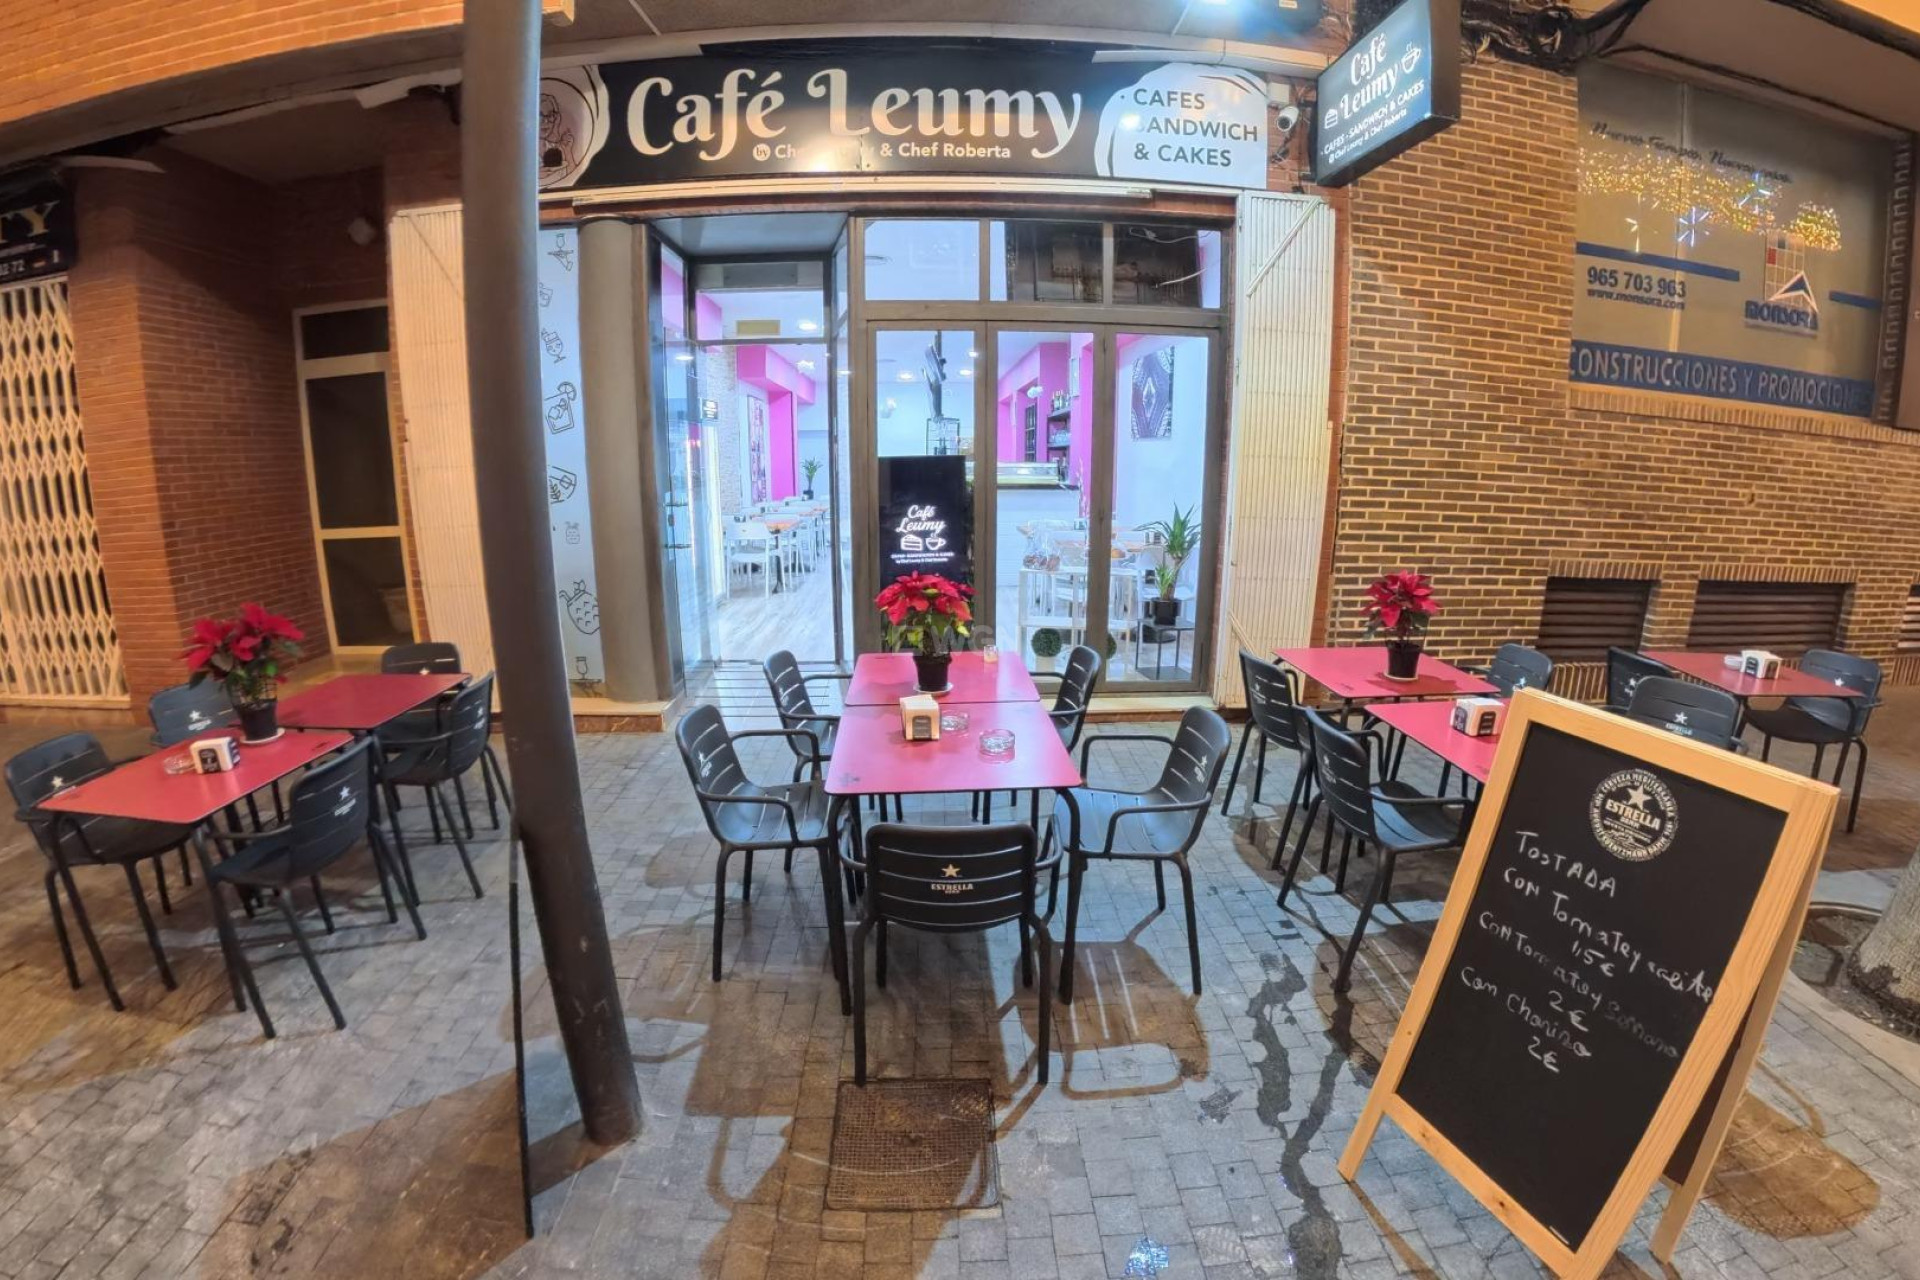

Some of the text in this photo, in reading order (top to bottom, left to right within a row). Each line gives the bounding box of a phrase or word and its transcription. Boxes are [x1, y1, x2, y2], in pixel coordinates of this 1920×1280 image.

[1350, 32, 1387, 86] Café
[1133, 88, 1206, 110] CAFES
[1340, 63, 1399, 120] Leumy
[627, 68, 1082, 162] Café Leumy
[1138, 116, 1258, 142] ANDWICH
[880, 142, 893, 157] &
[898, 140, 939, 158] Chef
[943, 142, 1011, 159] Roberta
[1134, 142, 1232, 167] & CAKES
[1587, 265, 1619, 288] 965
[1623, 271, 1653, 293] 703
[1743, 368, 1753, 395] Y
[907, 504, 936, 520] Café
[895, 517, 947, 534] Leumy
[1604, 799, 1662, 831] ESTRELLA
[931, 882, 974, 891] ESTRELLA
